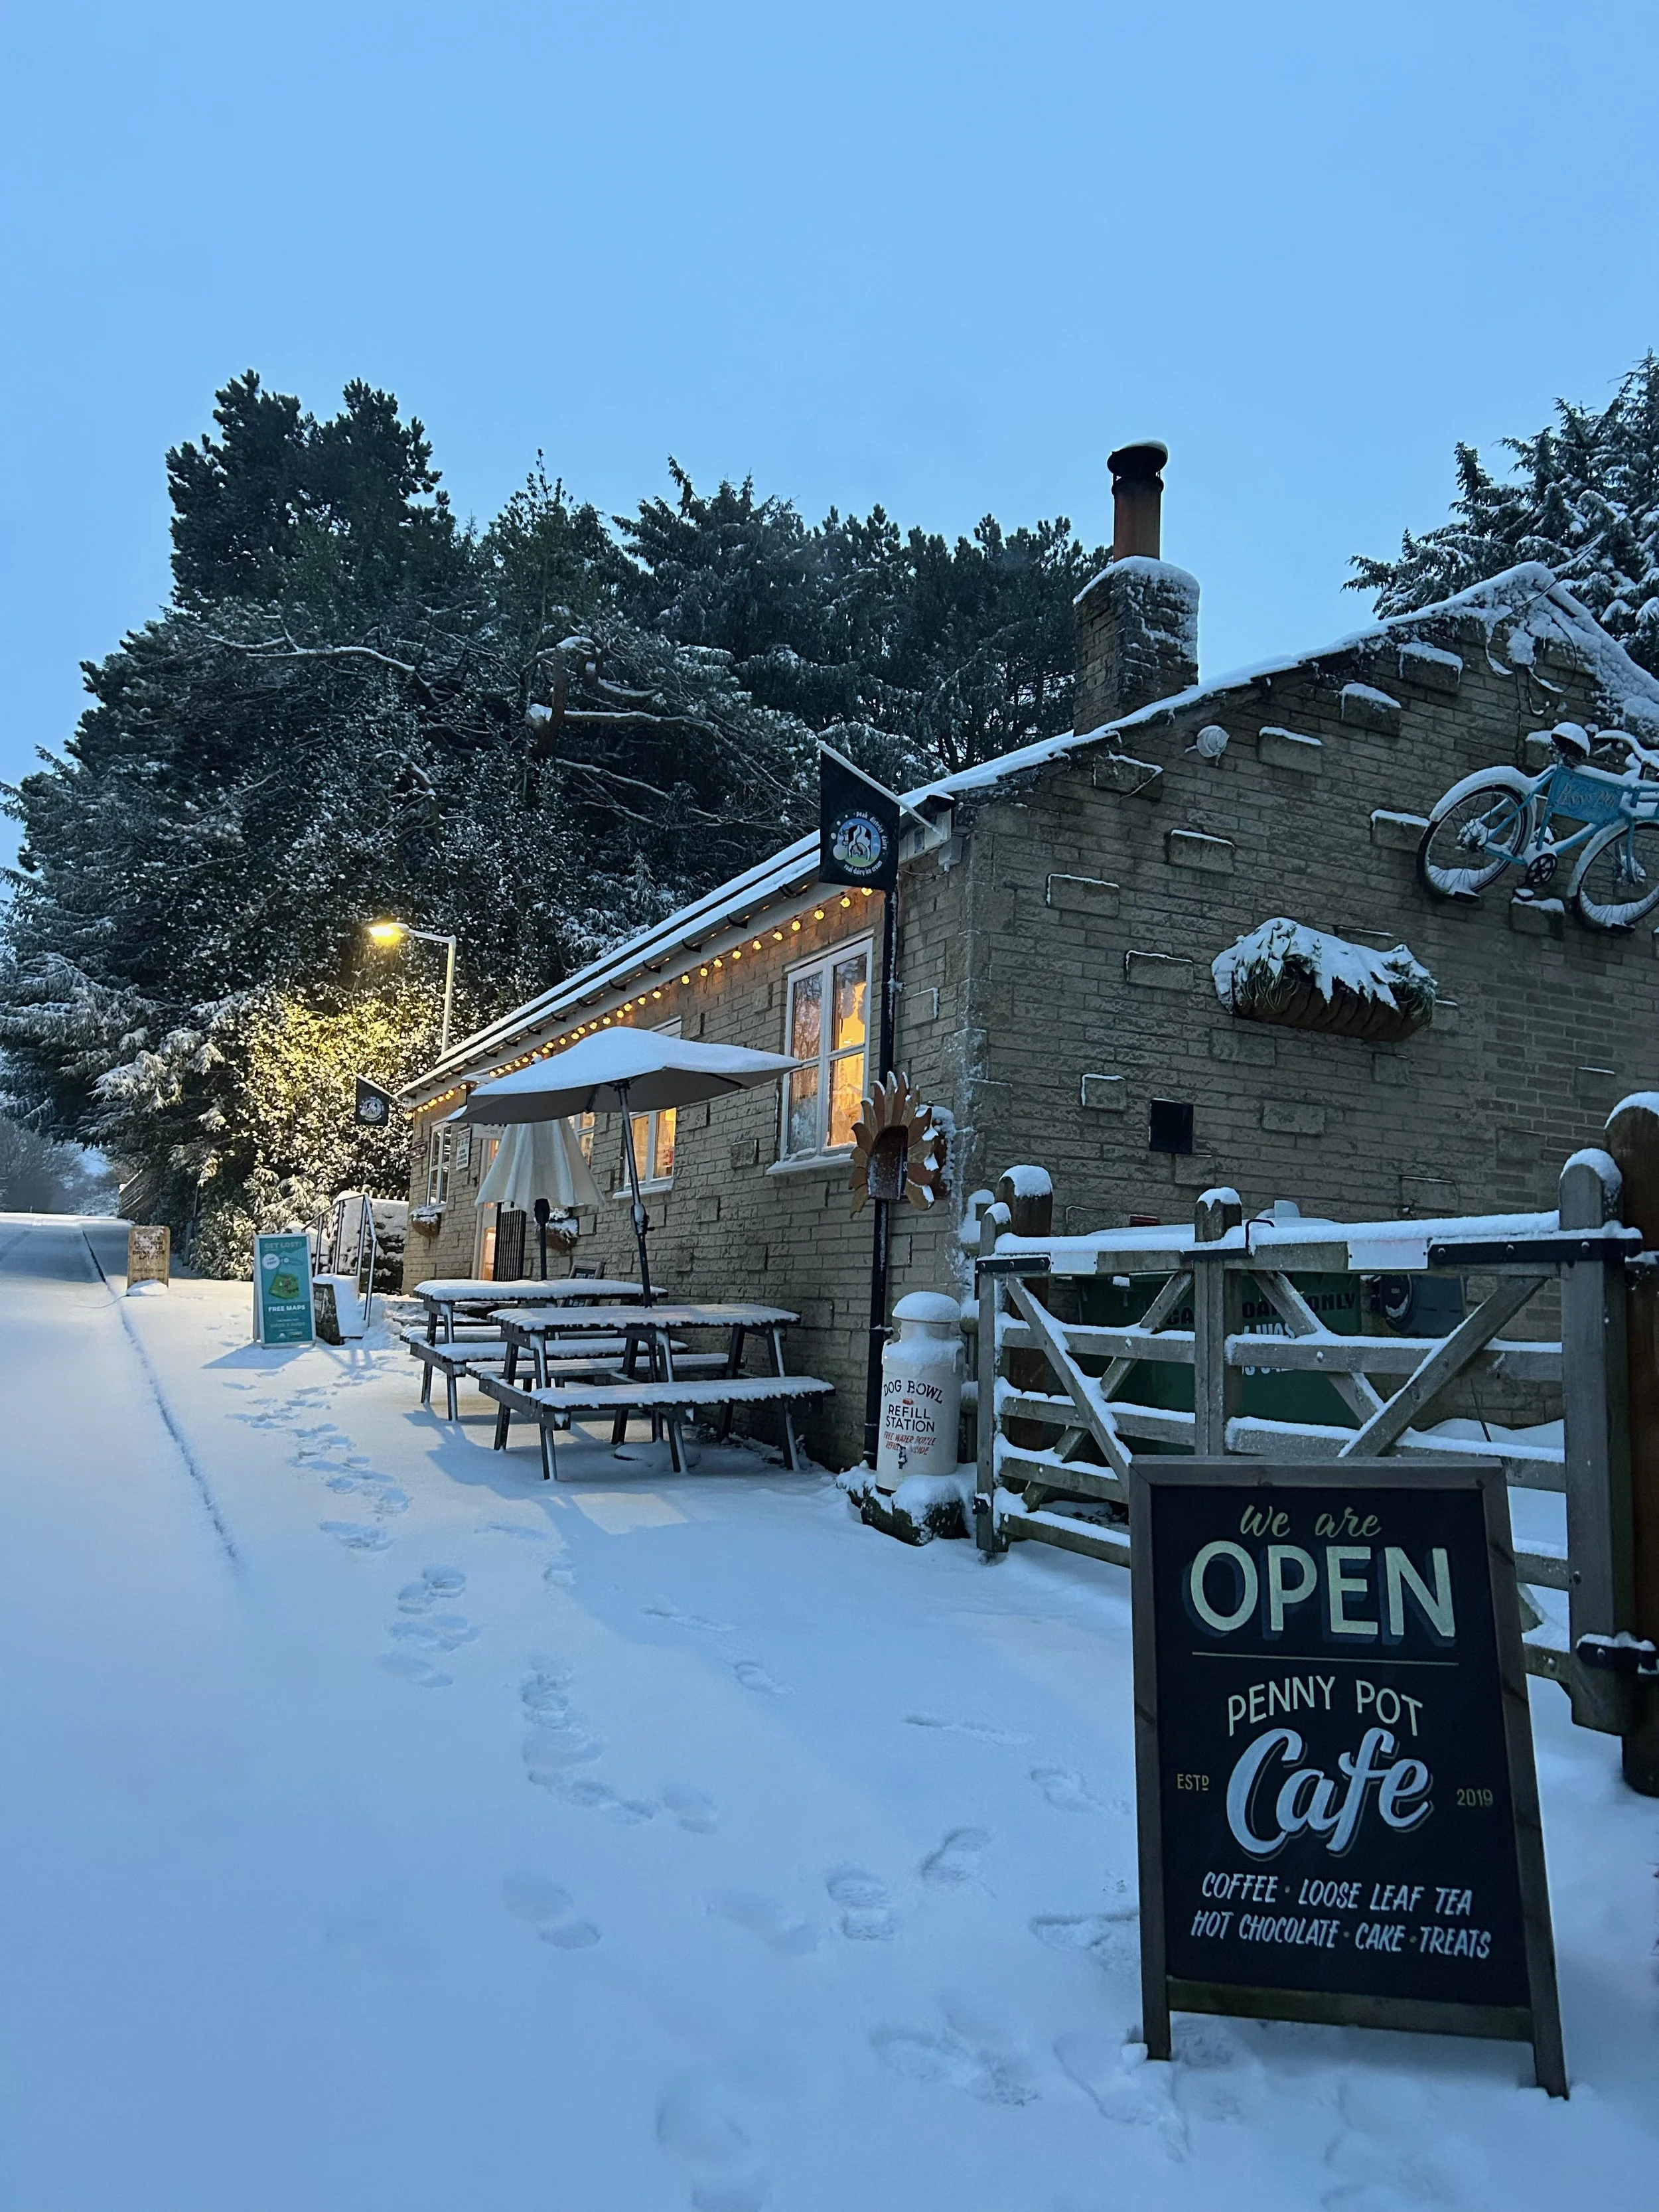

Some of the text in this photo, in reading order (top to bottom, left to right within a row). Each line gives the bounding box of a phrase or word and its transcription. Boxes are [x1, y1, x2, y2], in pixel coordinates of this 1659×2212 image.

[843, 864, 853, 873] real
[853, 867, 865, 876] dairy
[1307, 1292, 1355, 1312] ONLY
[884, 1380, 943, 1404] DOG BOWL
[888, 1404, 931, 1420] REFILL
[885, 1416, 935, 1433] STATION
[895, 1434, 914, 1443] WATER
[1315, 1507, 1382, 1538] are
[1190, 1540, 1455, 1638] OPEN
[1227, 1675, 1423, 1737] PENNY POT
[1226, 1727, 1431, 1854] Cafe
[1456, 1788, 1493, 1806] 2019
[1202, 1871, 1473, 1916] COFFEE LOOSE LEAF TEA
[1190, 1909, 1492, 1960] HOT CHOCOLATE CAKE TREATS
